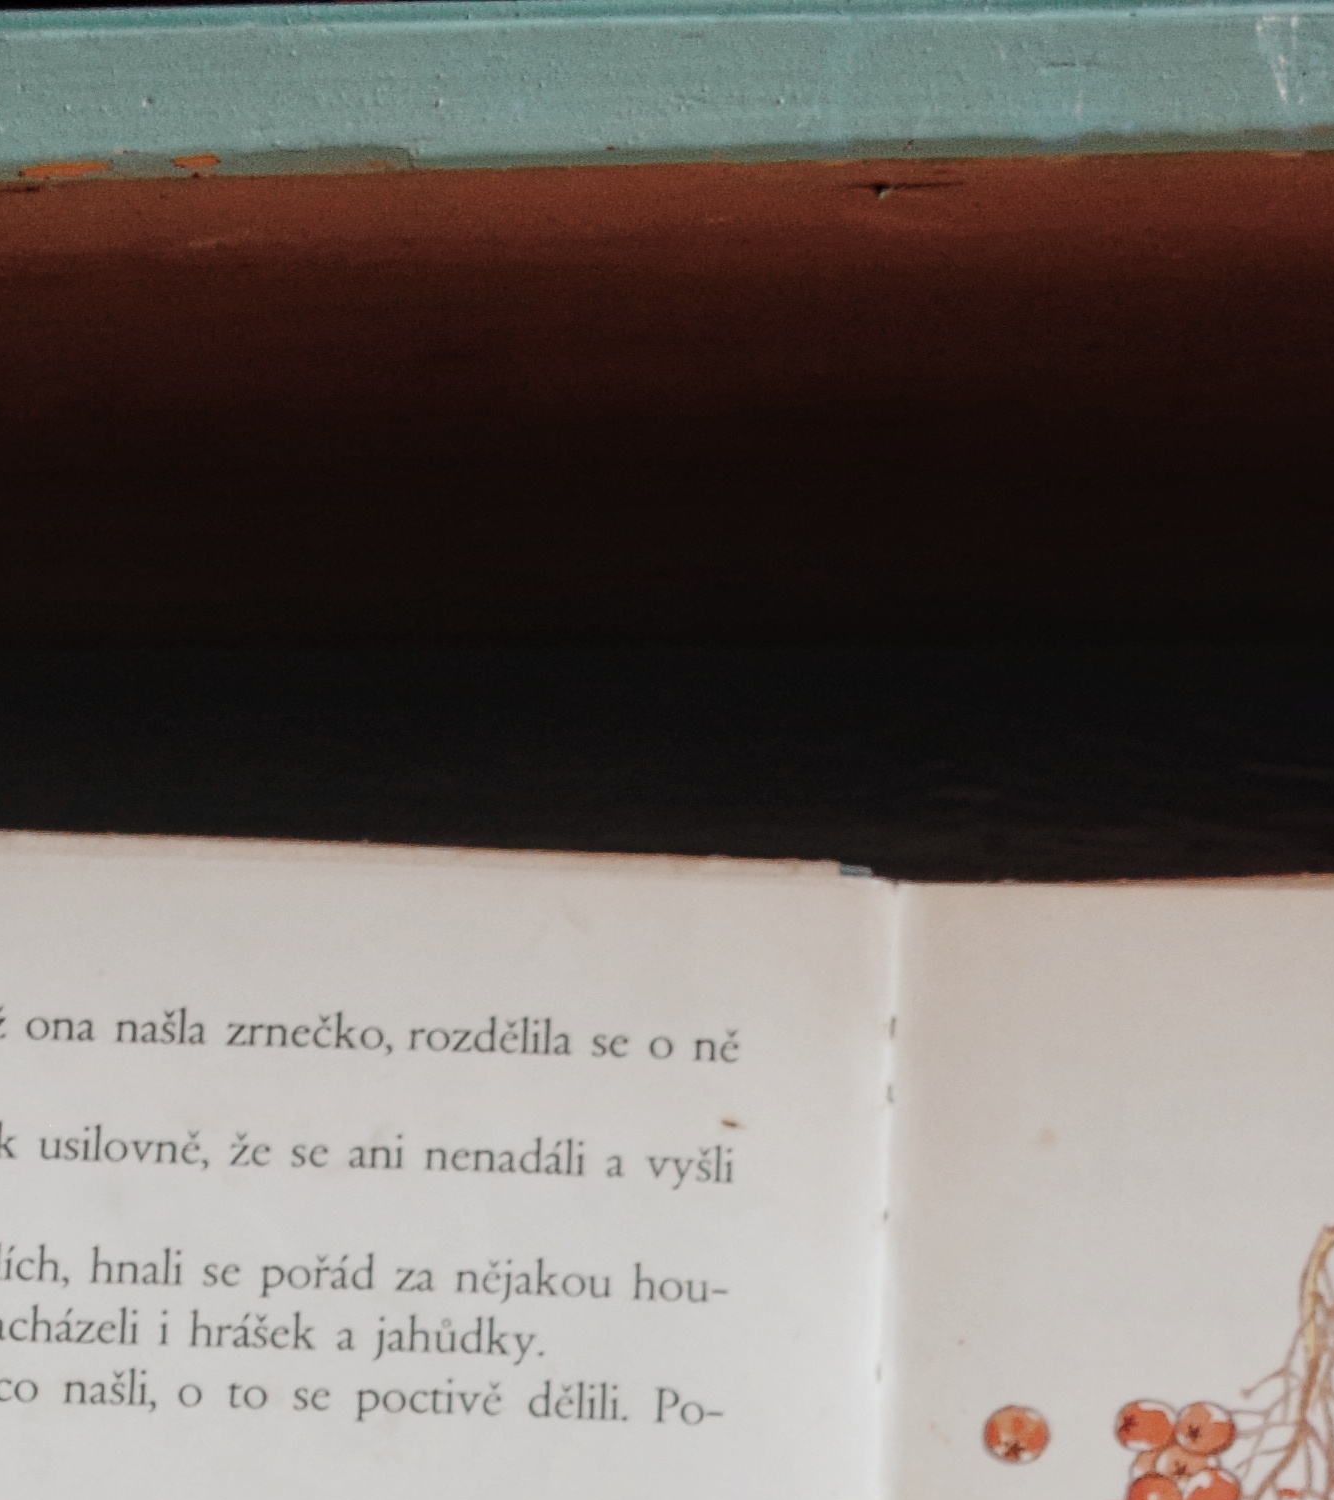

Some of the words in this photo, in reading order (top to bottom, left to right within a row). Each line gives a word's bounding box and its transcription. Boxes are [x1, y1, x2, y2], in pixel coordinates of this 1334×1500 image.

[25, 1016, 96, 1043] ona
[115, 1006, 206, 1046] našla
[225, 1010, 394, 1056] zrnečko,
[408, 1015, 572, 1056] rozdělila
[591, 1034, 630, 1059] se
[647, 1034, 676, 1061] o
[694, 1029, 740, 1064] ně
[39, 1123, 210, 1170] usilovně,
[229, 1133, 272, 1167] že
[290, 1144, 329, 1169] se
[348, 1133, 403, 1170] ani
[425, 1136, 585, 1177] nenadáli
[604, 1153, 625, 1179] a
[647, 1143, 733, 1191] vyšli
[89, 1244, 182, 1287] hnali
[202, 1263, 241, 1288] se
[259, 1251, 375, 1299] pořád
[395, 1267, 435, 1293] za
[455, 1257, 611, 1304] nějakou
[632, 1261, 729, 1304] hou-
[158, 1308, 170, 1347] i
[189, 1308, 316, 1351] hrášek
[335, 1326, 357, 1353] a
[373, 1313, 545, 1366] jahůdky.
[62, 1367, 157, 1413] našli,
[176, 1382, 204, 1409] o
[228, 1382, 269, 1410] to
[292, 1387, 331, 1412] se
[355, 1378, 502, 1423] poctivě
[527, 1378, 629, 1422] dělili.
[655, 1386, 724, 1425] Po-
